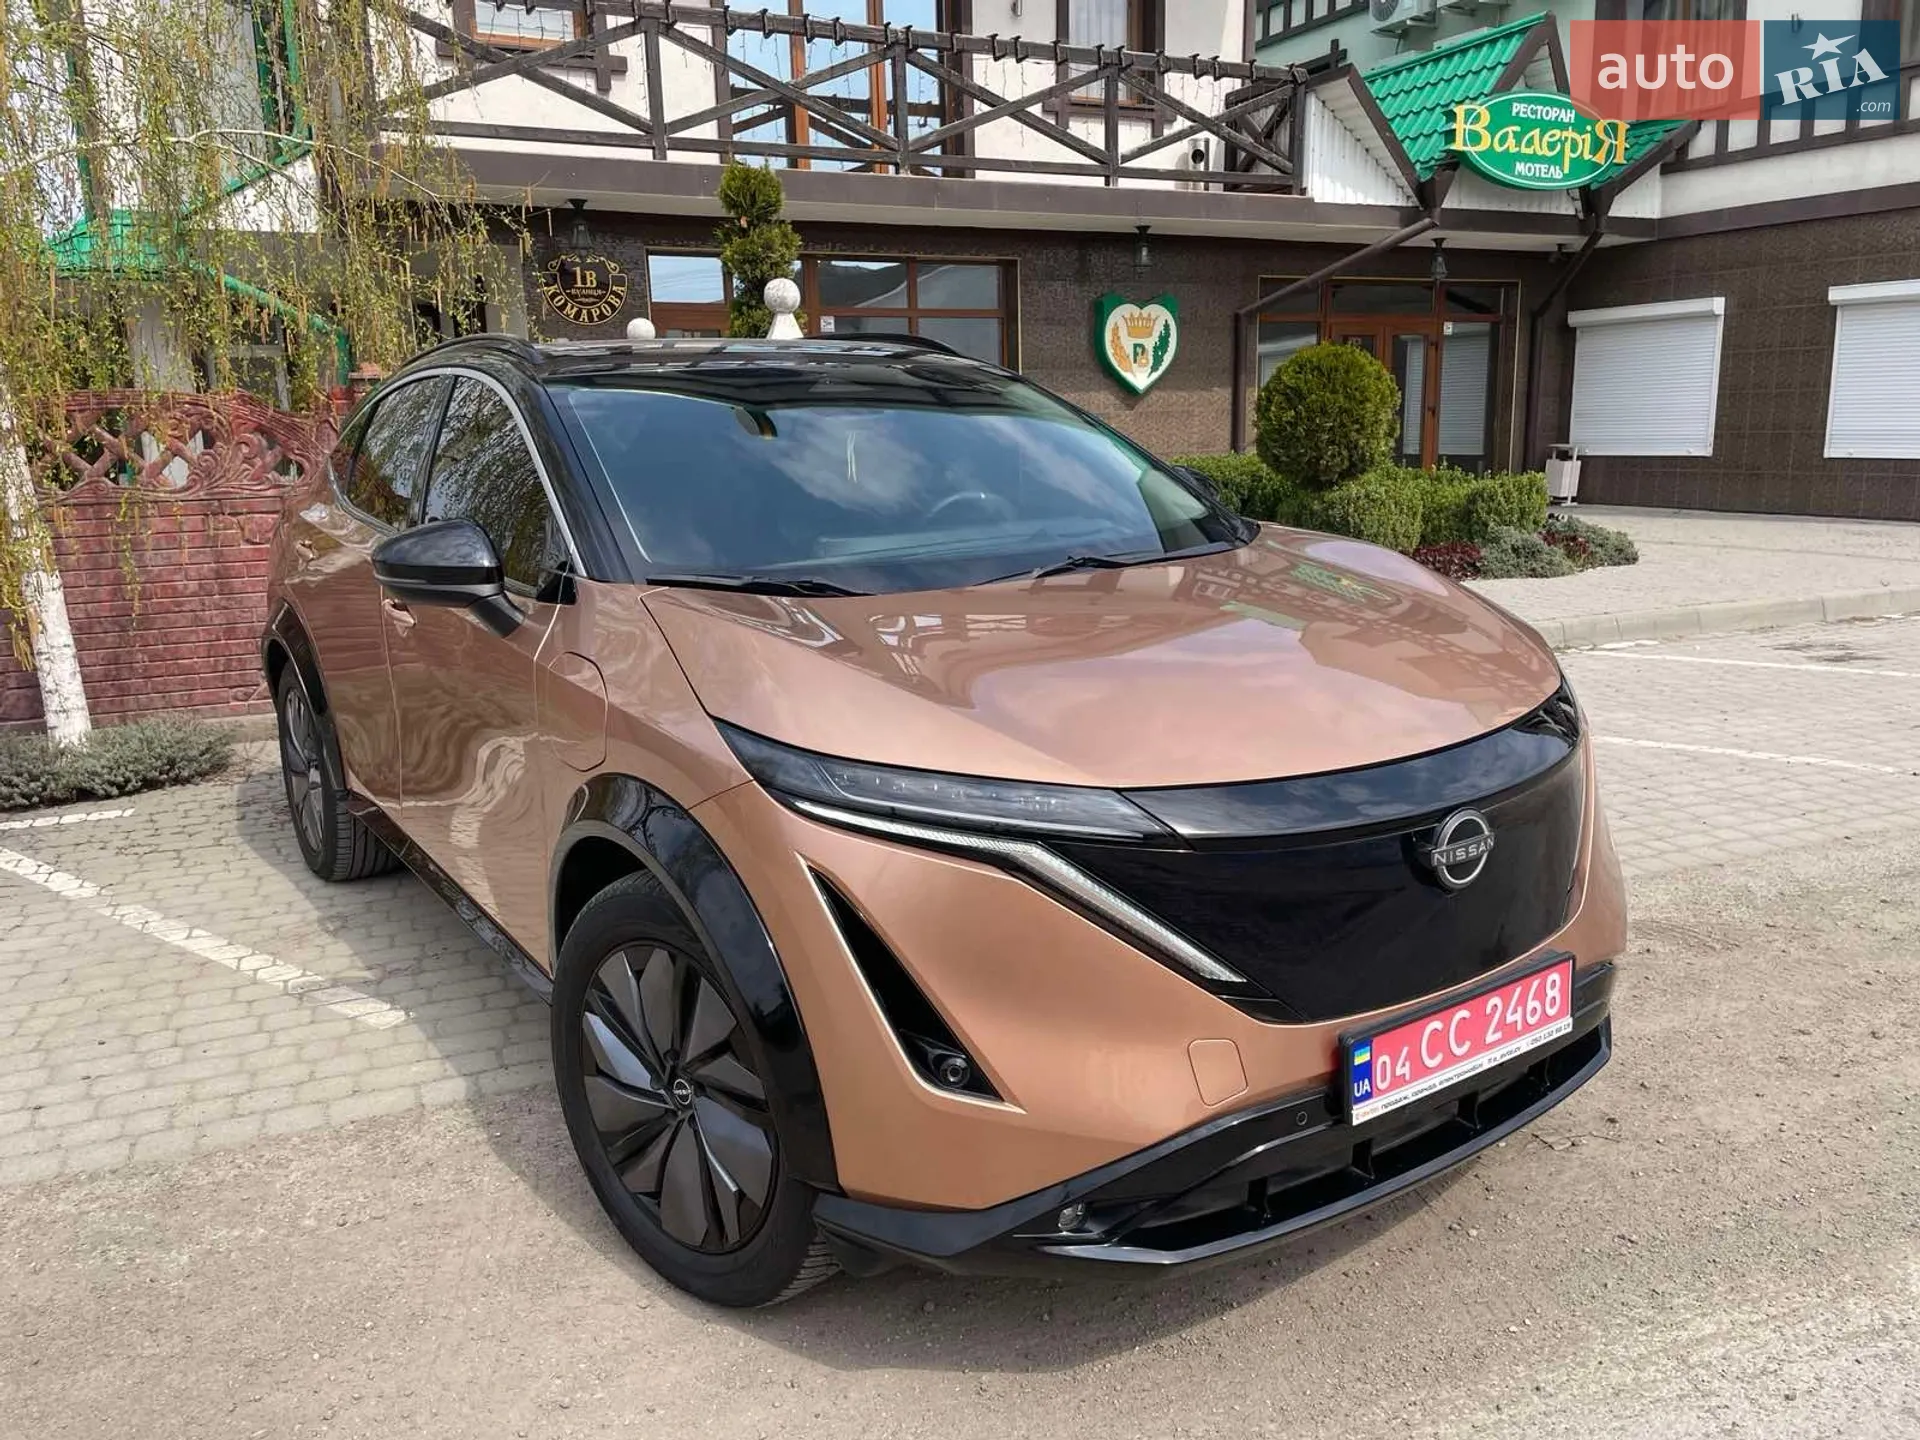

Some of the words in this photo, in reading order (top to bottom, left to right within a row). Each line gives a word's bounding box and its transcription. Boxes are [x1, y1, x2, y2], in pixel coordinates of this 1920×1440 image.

[1511, 102, 1576, 124] РЕСТОРАН
[1514, 161, 1564, 180] МОТЕЛЬ
[544, 284, 626, 322] КОМАРОВА
[1433, 837, 1494, 865] NISSAN
[1375, 1045, 1412, 1091] 04
[1420, 1009, 1472, 1069] CC
[1484, 972, 1562, 1045] 2468
[1353, 1078, 1371, 1098] UA
